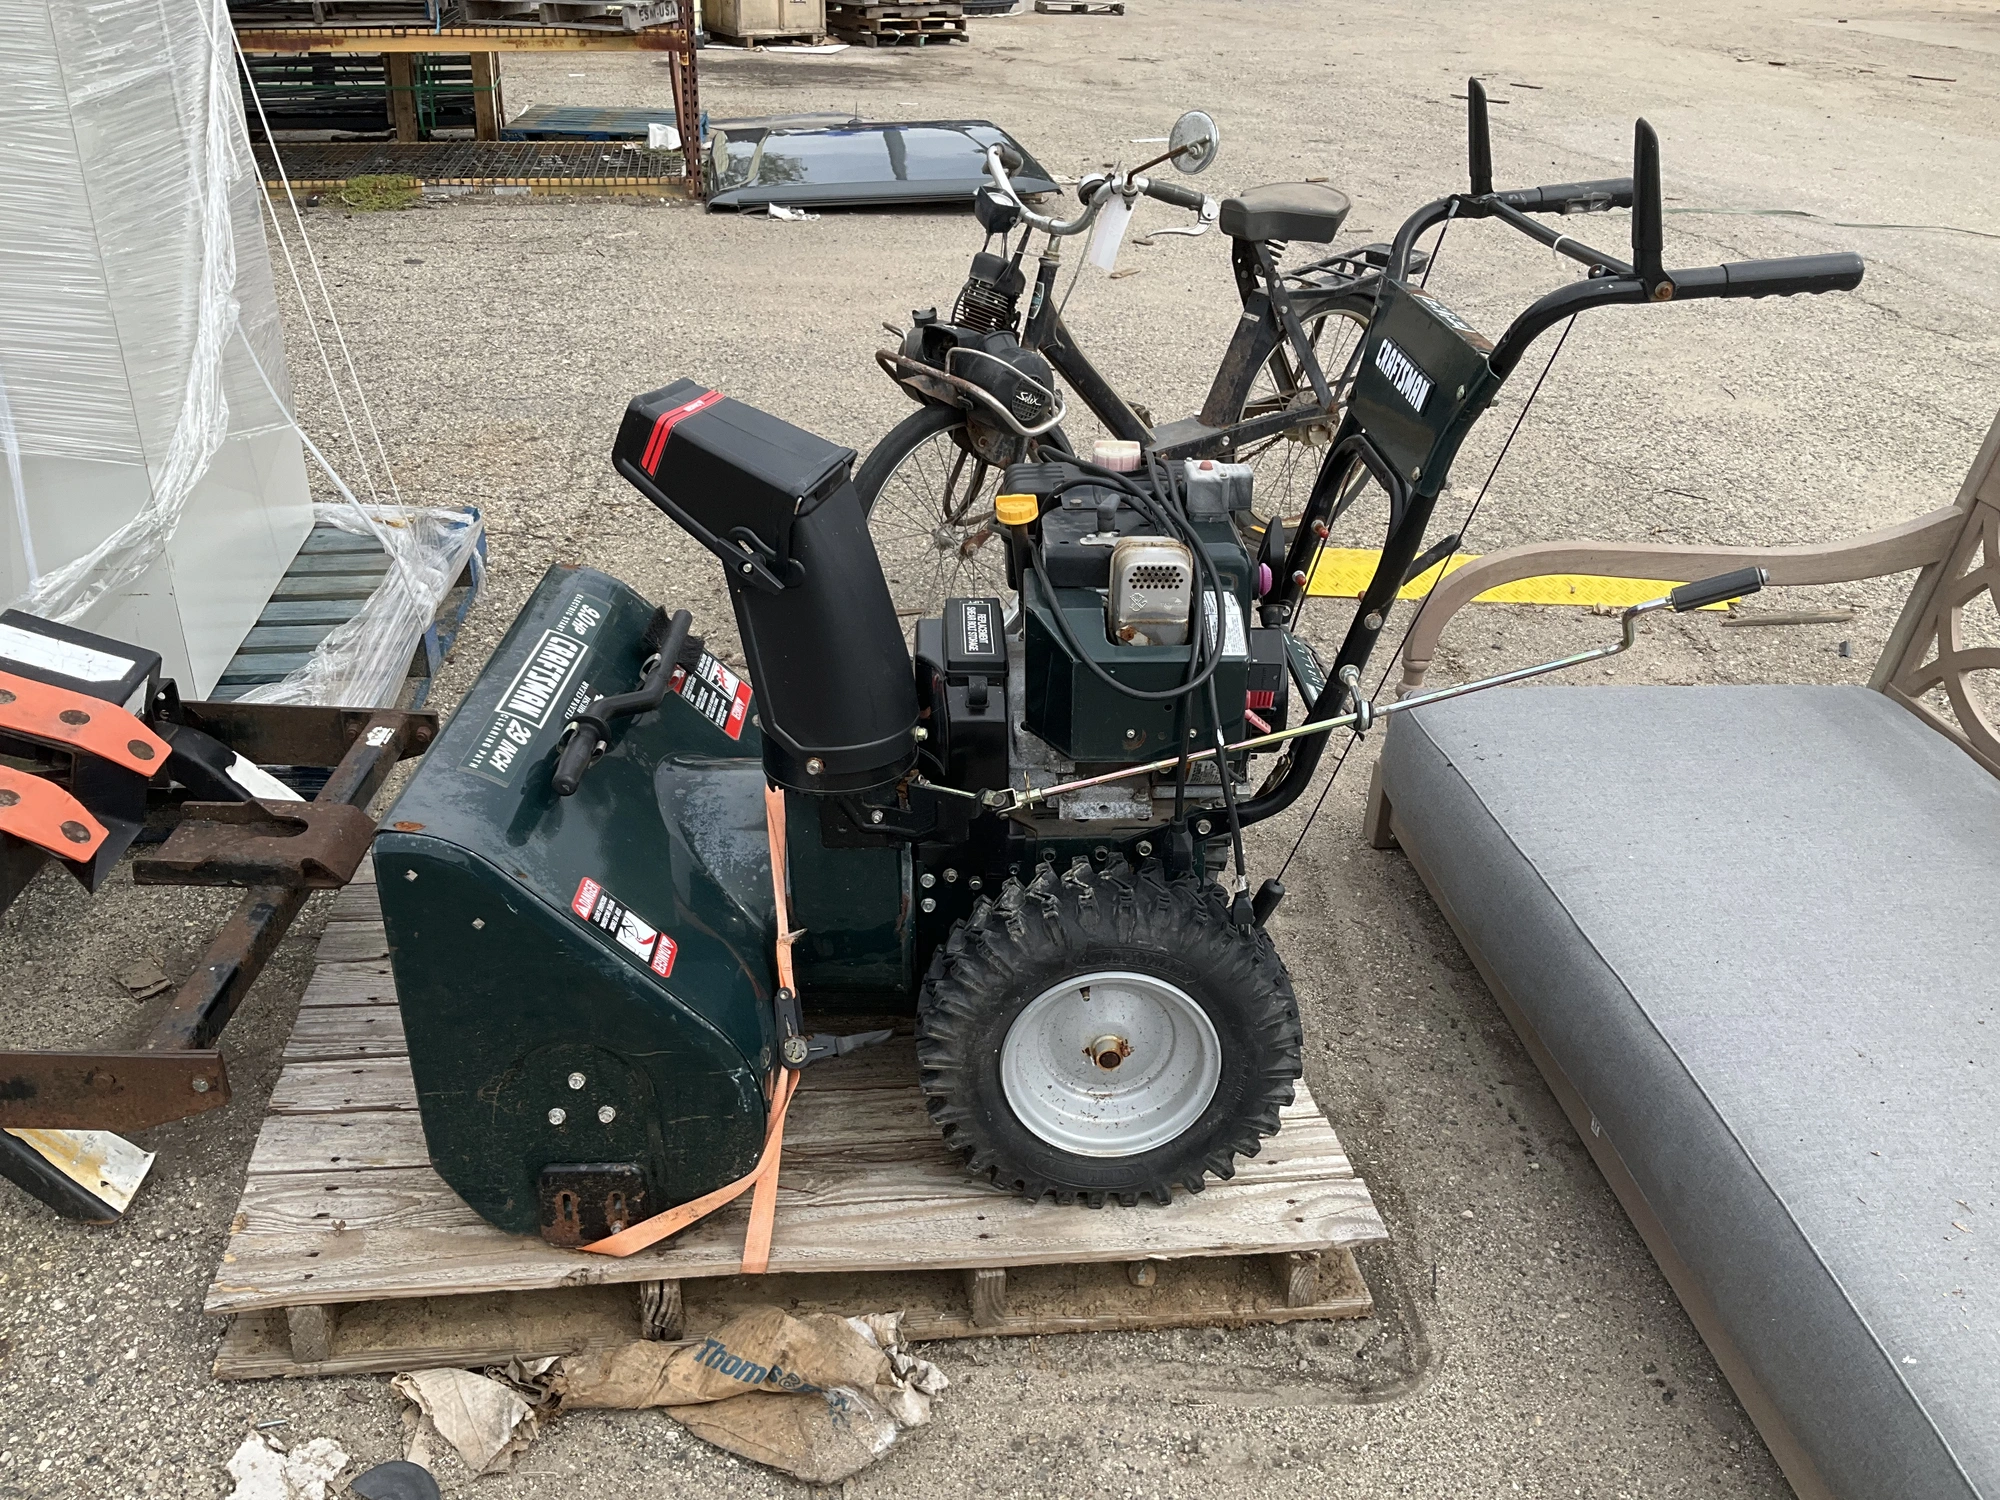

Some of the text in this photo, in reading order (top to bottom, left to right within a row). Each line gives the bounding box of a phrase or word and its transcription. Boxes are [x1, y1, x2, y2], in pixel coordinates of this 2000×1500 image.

[1375, 338, 1431, 413] CRAFTSMAN
[556, 594, 584, 632] ELECTRIC START
[966, 606, 979, 651] SHEAR BOLT STORAGE
[977, 613, 989, 644] REPLACEMENT
[508, 636, 579, 719] CRAFTSMAN
[564, 701, 578, 720] CLEAN
[576, 680, 590, 699] CLEAR
[468, 713, 509, 769] CLEARING PATH
[488, 718, 532, 773] 29 INCH
[578, 879, 599, 907] DANGER
[653, 946, 672, 975] DANGER
